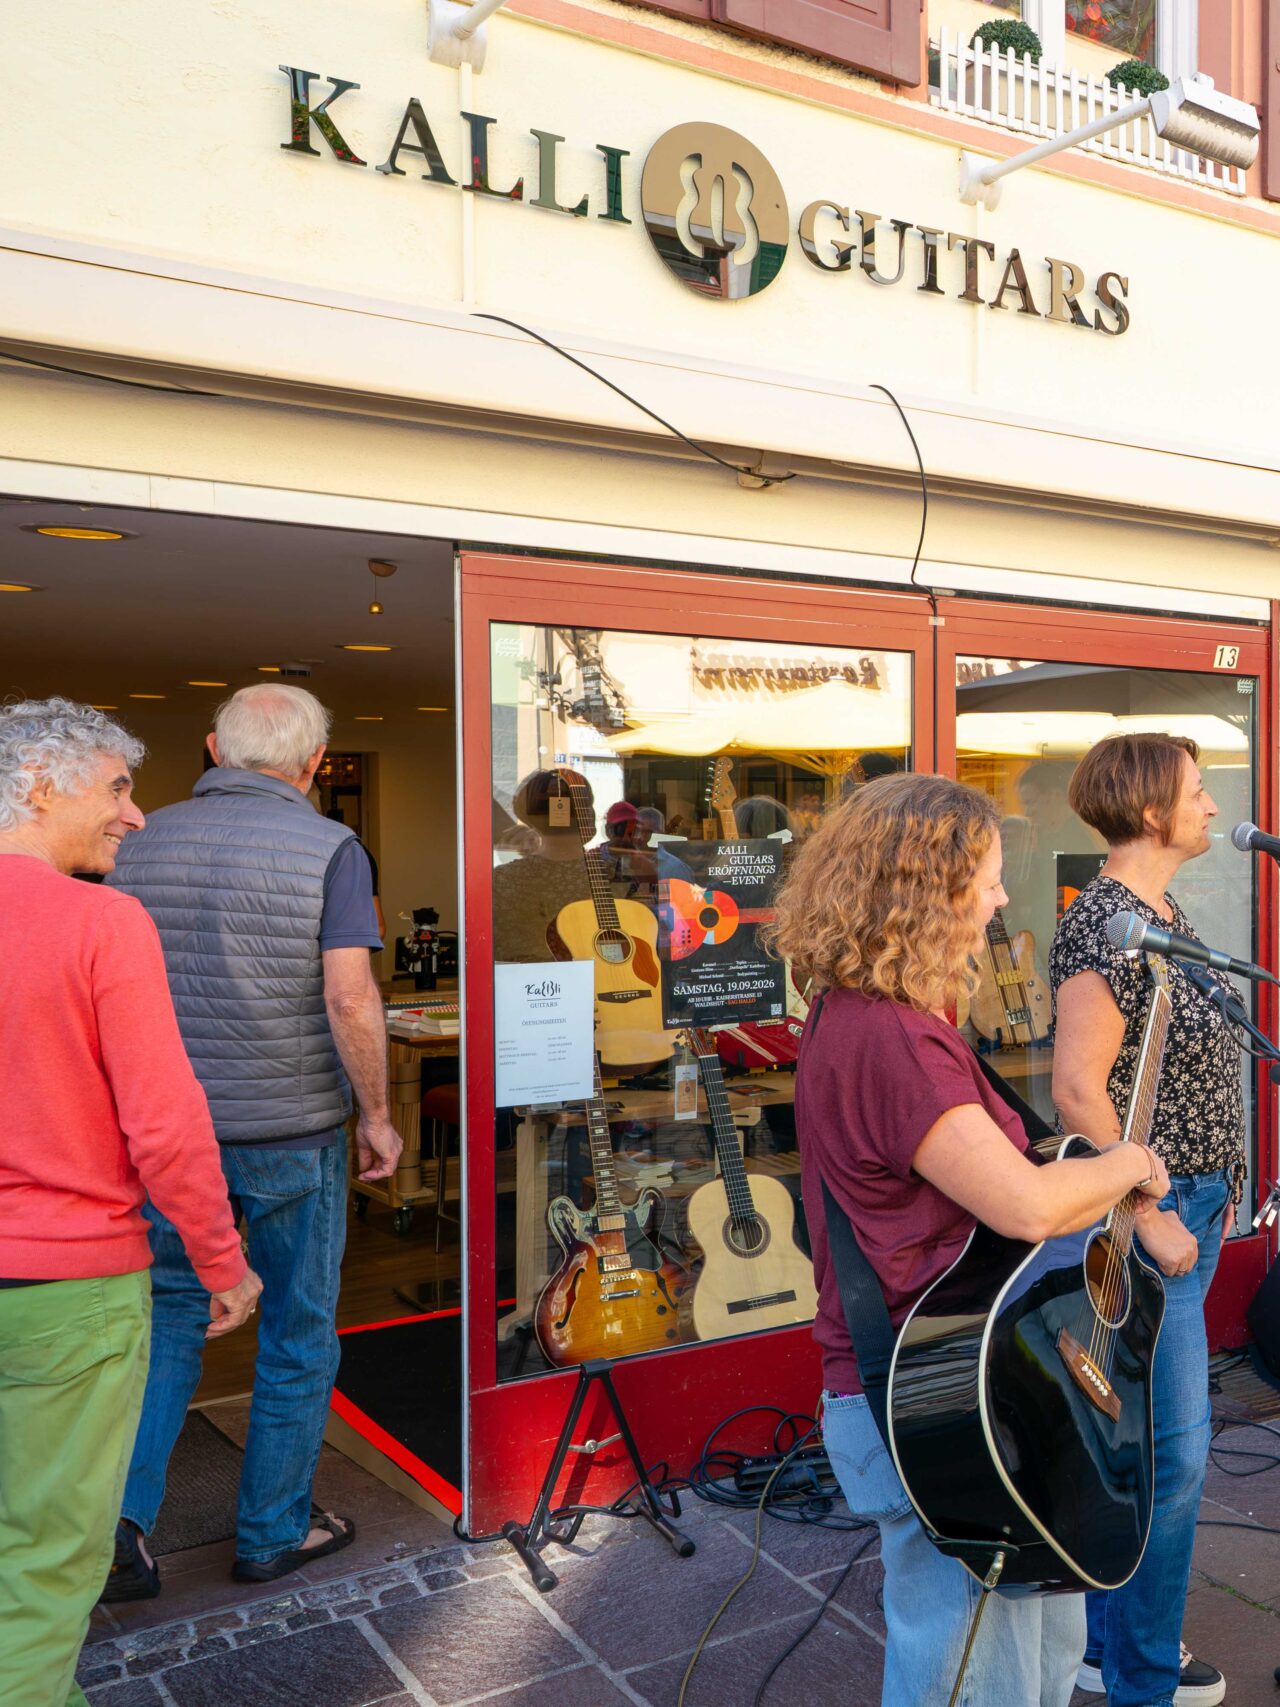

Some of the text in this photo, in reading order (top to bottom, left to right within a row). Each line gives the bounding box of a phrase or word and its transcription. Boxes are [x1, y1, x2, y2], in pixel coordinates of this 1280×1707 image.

[279, 64, 1130, 336] KALLI GUITARS
[1218, 647, 1237, 667] 13
[717, 845, 747, 855] KALLI
[729, 855, 774, 865] GUITARS
[708, 864, 776, 876] ERÖFFNUNGS
[673, 979, 775, 996] SAMSTAG, 19.09.2026
[715, 992, 756, 1001] KAISERSTRASSE
[529, 1001, 558, 1009] GUITARS
[694, 1000, 725, 1008] WALDSHUT
